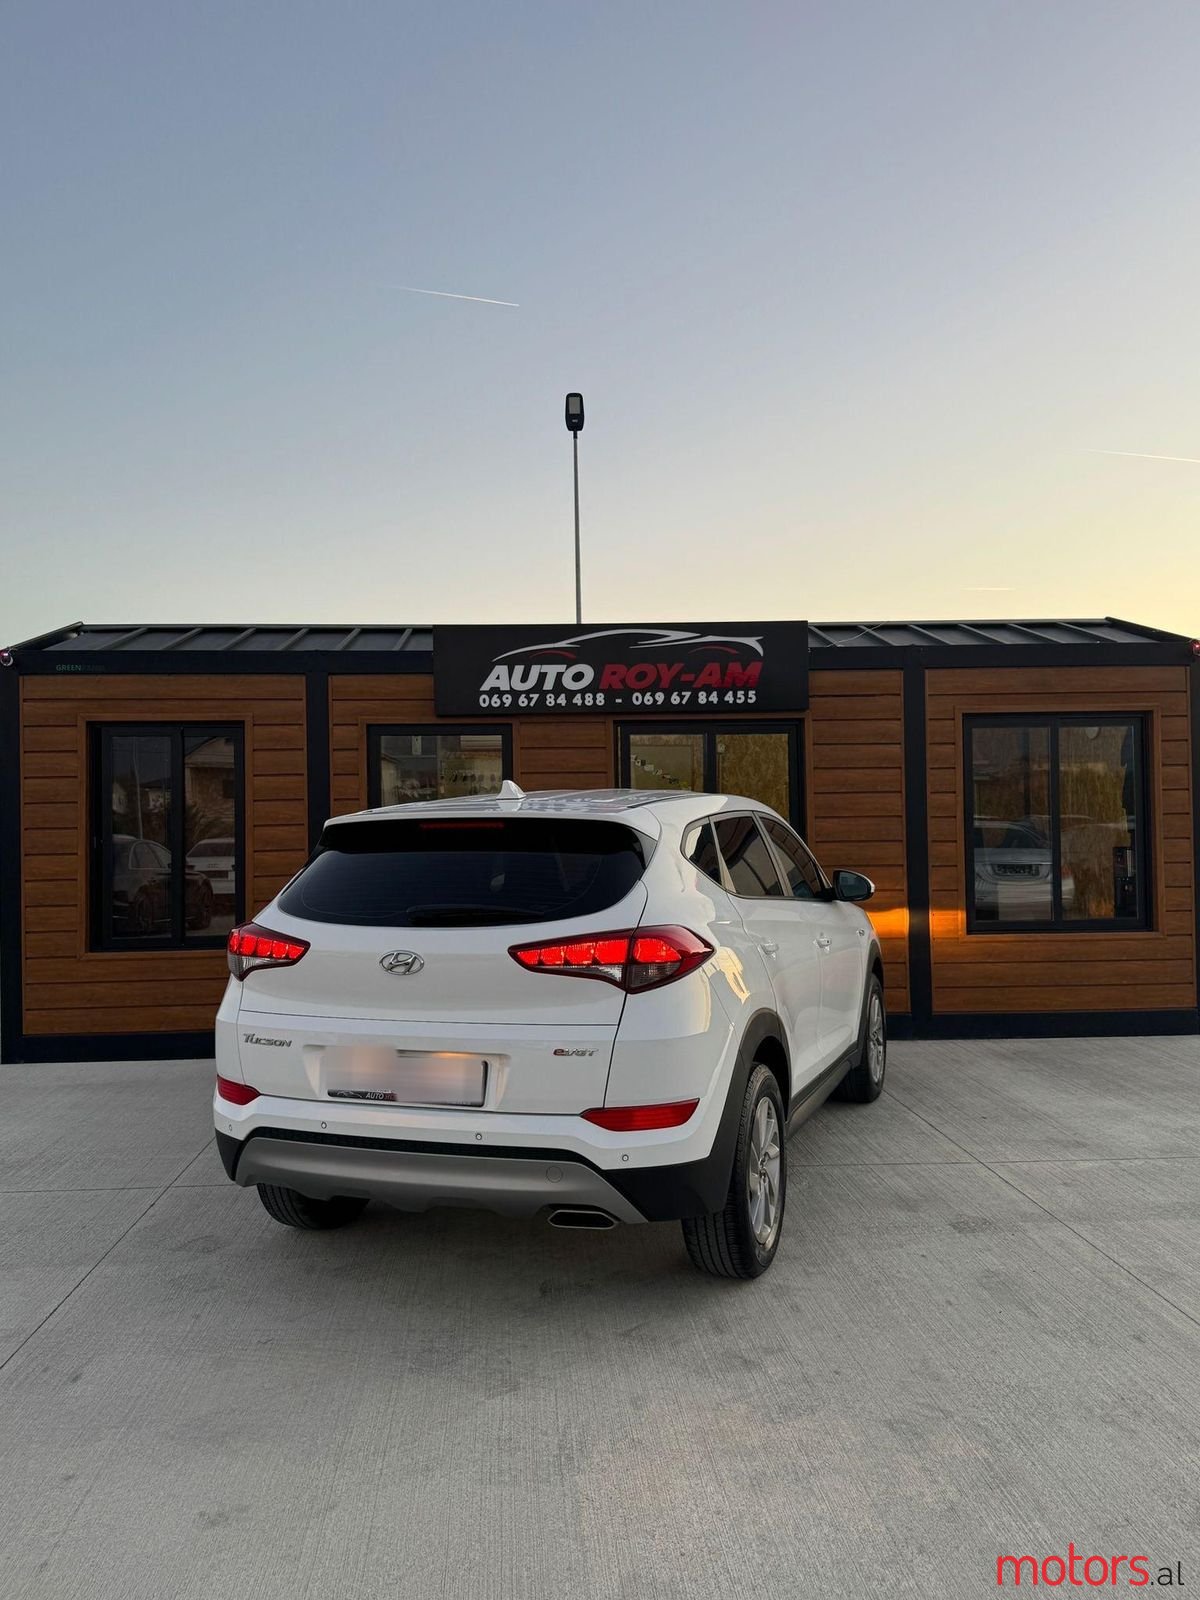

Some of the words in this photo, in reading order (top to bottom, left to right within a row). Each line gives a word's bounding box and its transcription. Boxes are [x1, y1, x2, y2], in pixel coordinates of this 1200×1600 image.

[479, 663, 595, 691] AUTO
[599, 661, 763, 690] ROY-AM
[479, 694, 512, 707] 069
[518, 694, 540, 707] 67
[545, 693, 567, 706] 84
[572, 692, 605, 706] 488
[631, 691, 665, 706] 069
[670, 691, 692, 705] 67
[698, 691, 719, 704] 84
[724, 690, 757, 704] 455
